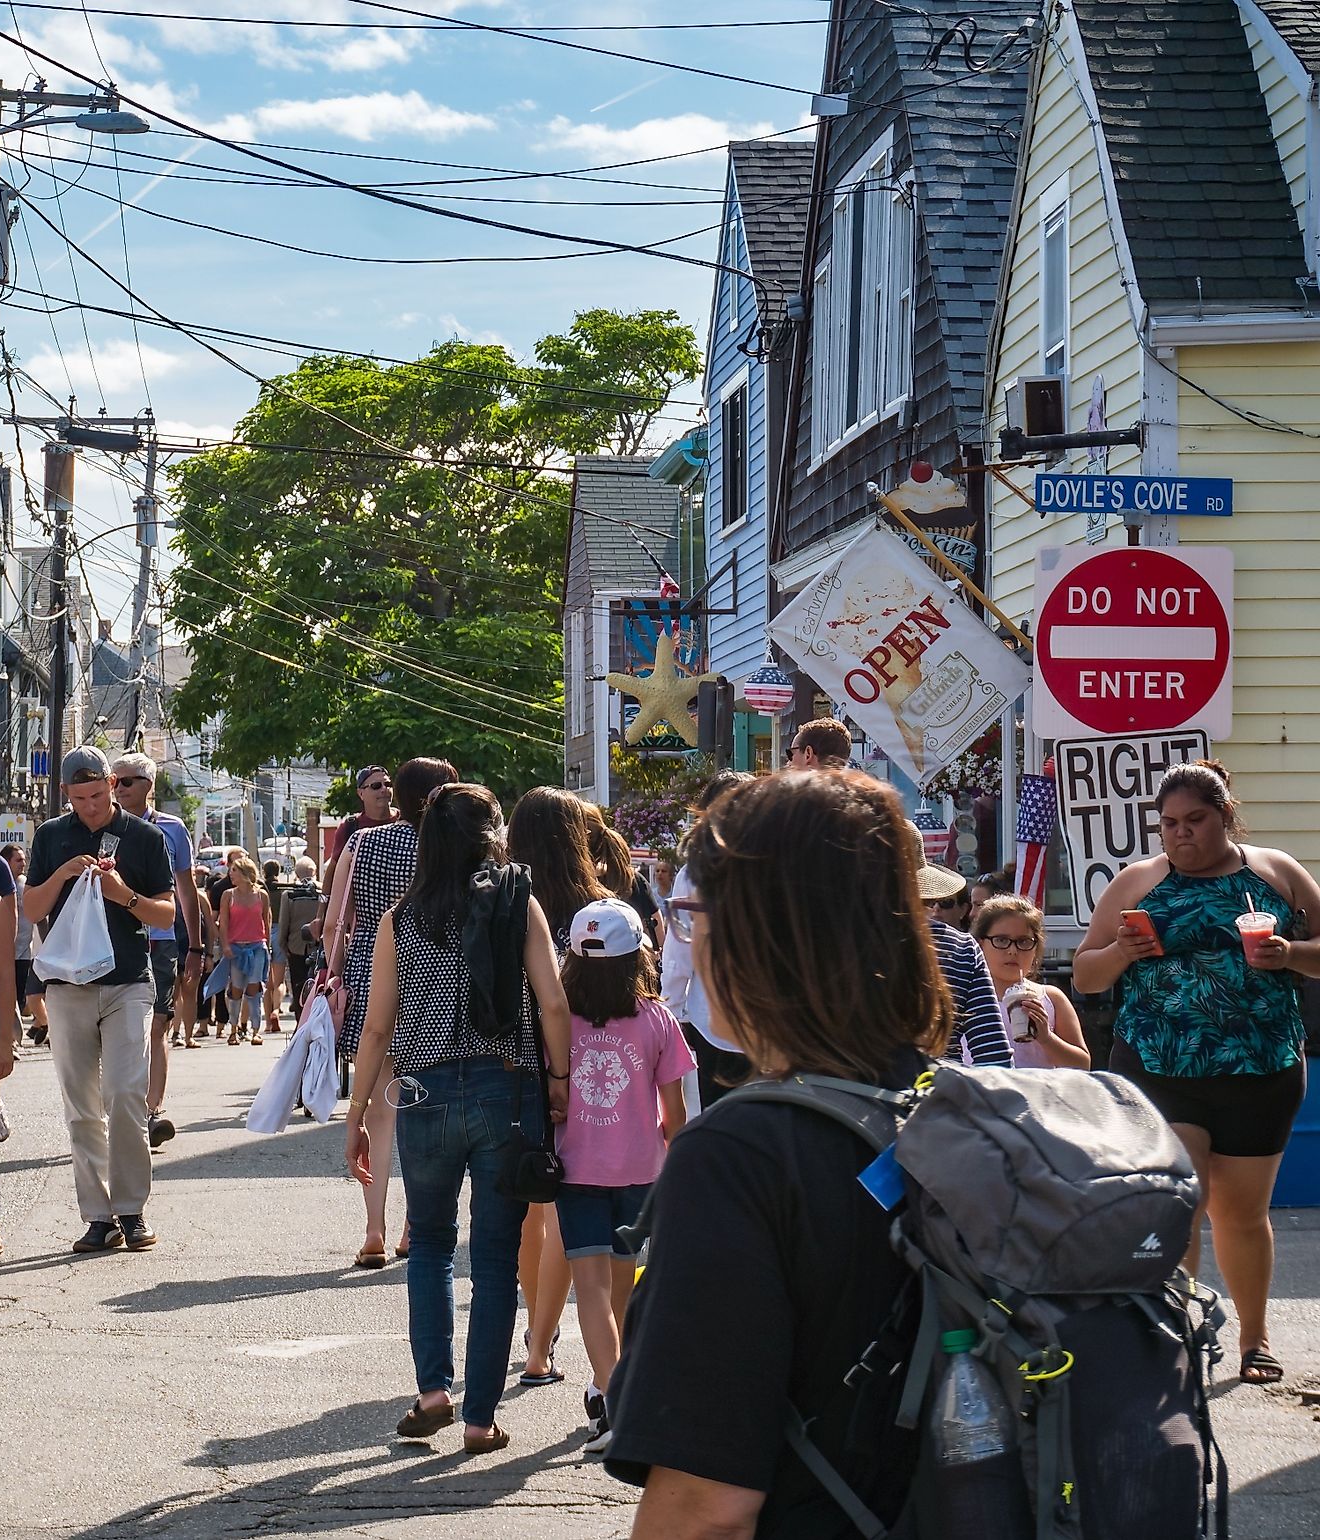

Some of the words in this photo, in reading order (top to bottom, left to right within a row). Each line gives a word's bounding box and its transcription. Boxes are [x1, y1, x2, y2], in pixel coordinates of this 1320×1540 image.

[1041, 479, 1124, 509] DOYLE'S
[1134, 481, 1188, 510] COVE
[1206, 498, 1224, 512] RD
[794, 571, 841, 643] Featuring
[1067, 586, 1112, 615] DO
[1137, 587, 1201, 615] NOT
[844, 595, 952, 704] OPEN
[1079, 671, 1185, 699] ENTER
[935, 710, 947, 722] ICE
[945, 691, 966, 712] CREAM
[1066, 737, 1198, 801] RIGHT
[1070, 801, 1163, 860] TUR
[1084, 862, 1129, 923] O
[579, 1031, 624, 1047] Coolest
[623, 1043, 645, 1071] Gals
[575, 1109, 620, 1126] Around
